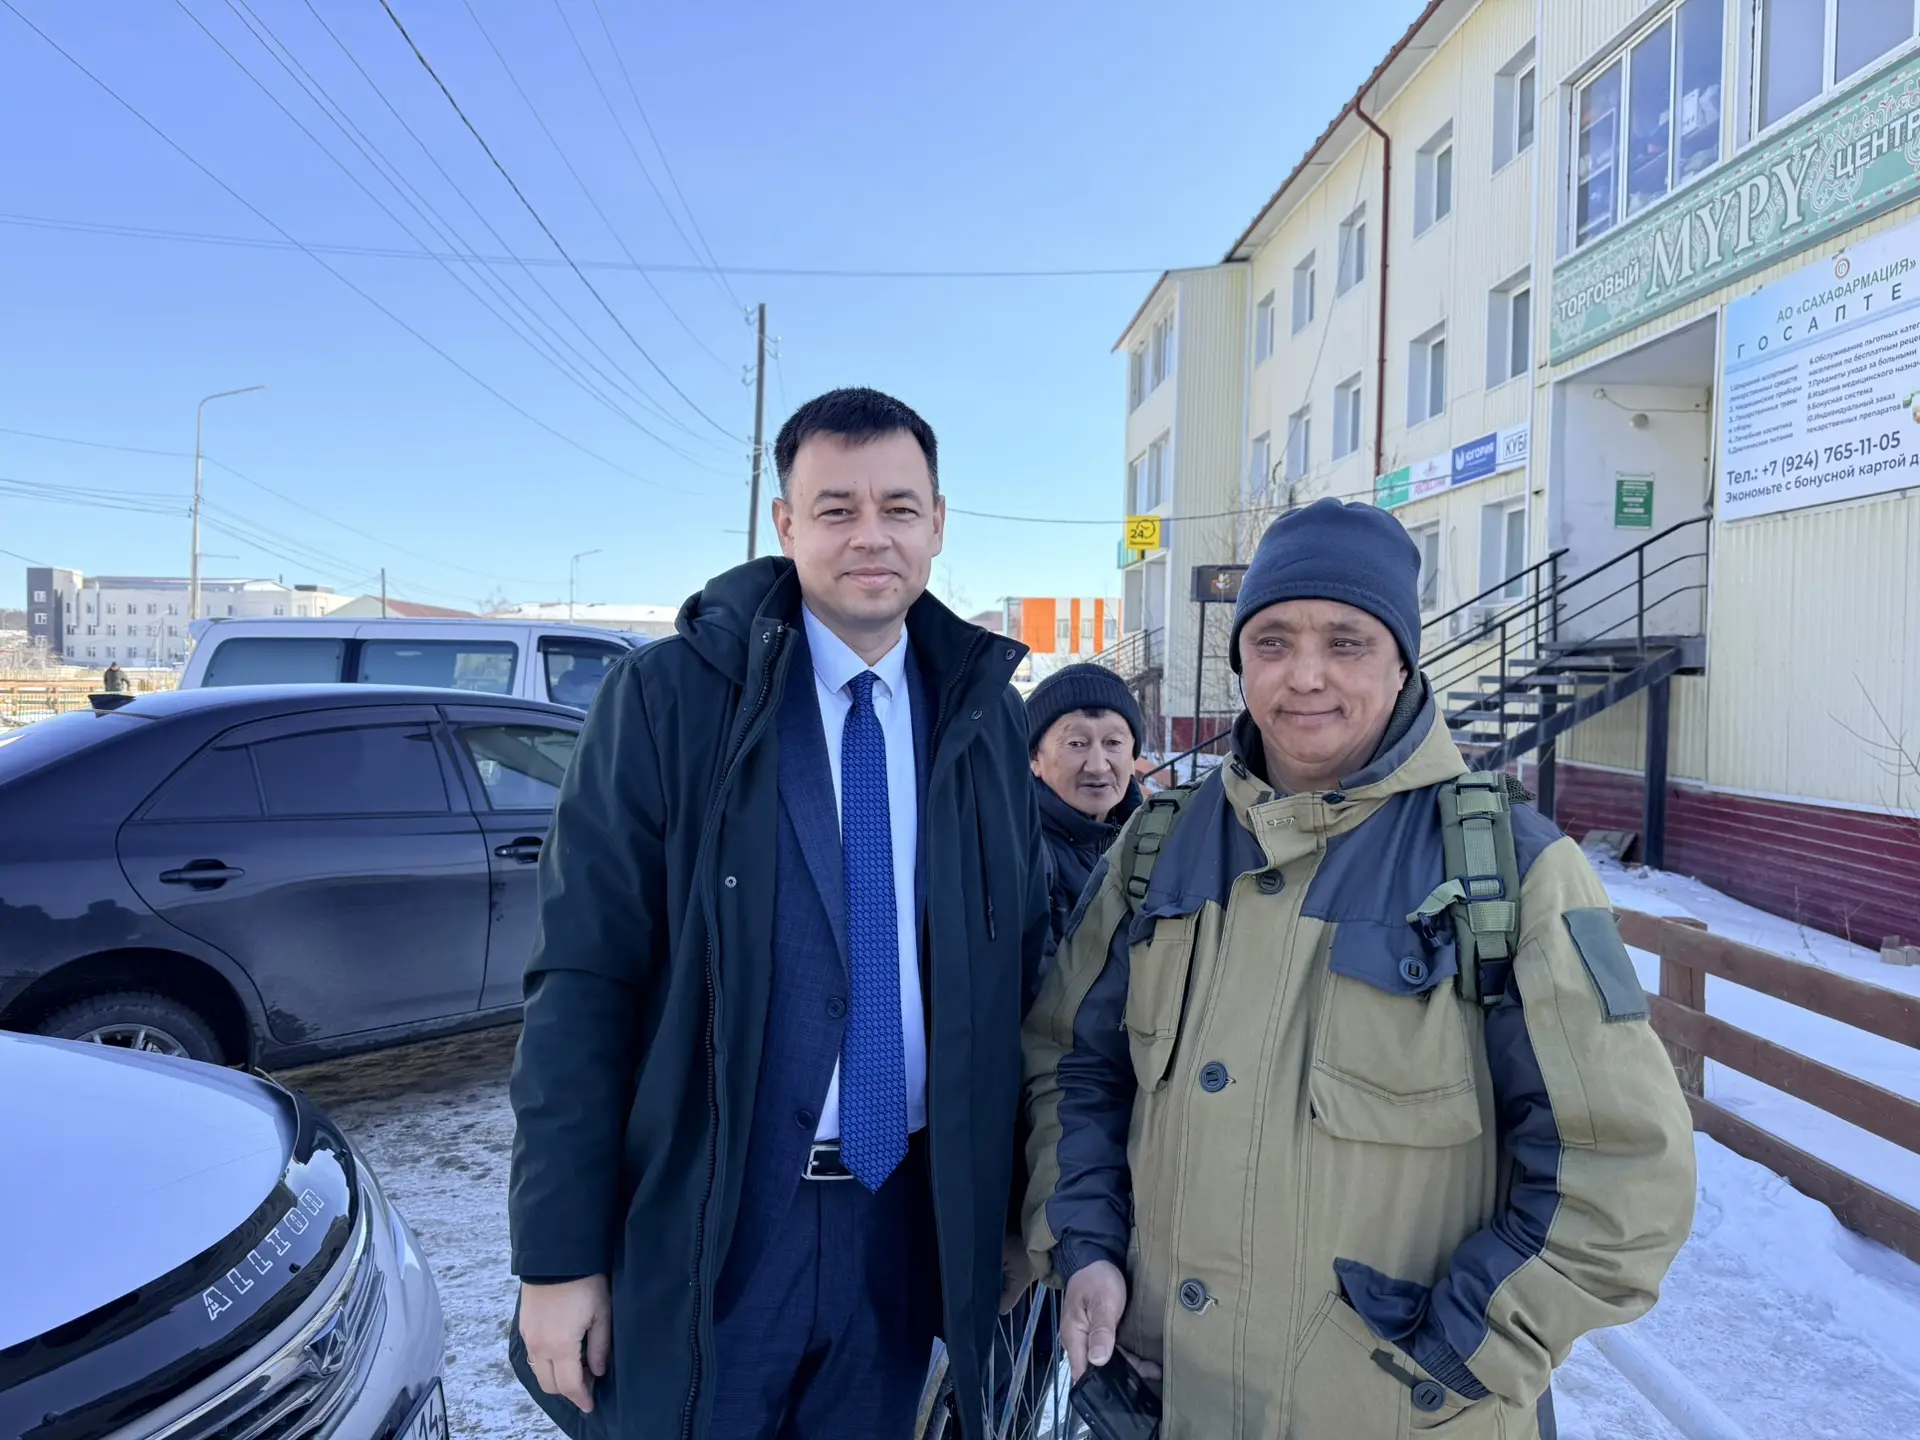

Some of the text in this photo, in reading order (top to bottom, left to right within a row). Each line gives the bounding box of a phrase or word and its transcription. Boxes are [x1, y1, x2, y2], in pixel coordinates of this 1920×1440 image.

[1559, 107, 1920, 320] ТОРГОВЫЙ МУРУ ЦЕНТР
[1776, 257, 1917, 323] АО «САХАФАРМАЦИЯ»
[1854, 344, 1898, 362] бесплатным
[1900, 335, 1920, 348] реце
[1878, 348, 1917, 365] больными
[1725, 482, 1782, 504] Экономьте
[1785, 481, 1791, 491] с
[1795, 467, 1855, 489] бонусной
[1858, 452, 1906, 476] картой
[1727, 430, 1901, 486] Тел.: +7 (924) 765-11-05
[1130, 529, 1144, 539] 24
[202, 1188, 325, 1322] ALLION
